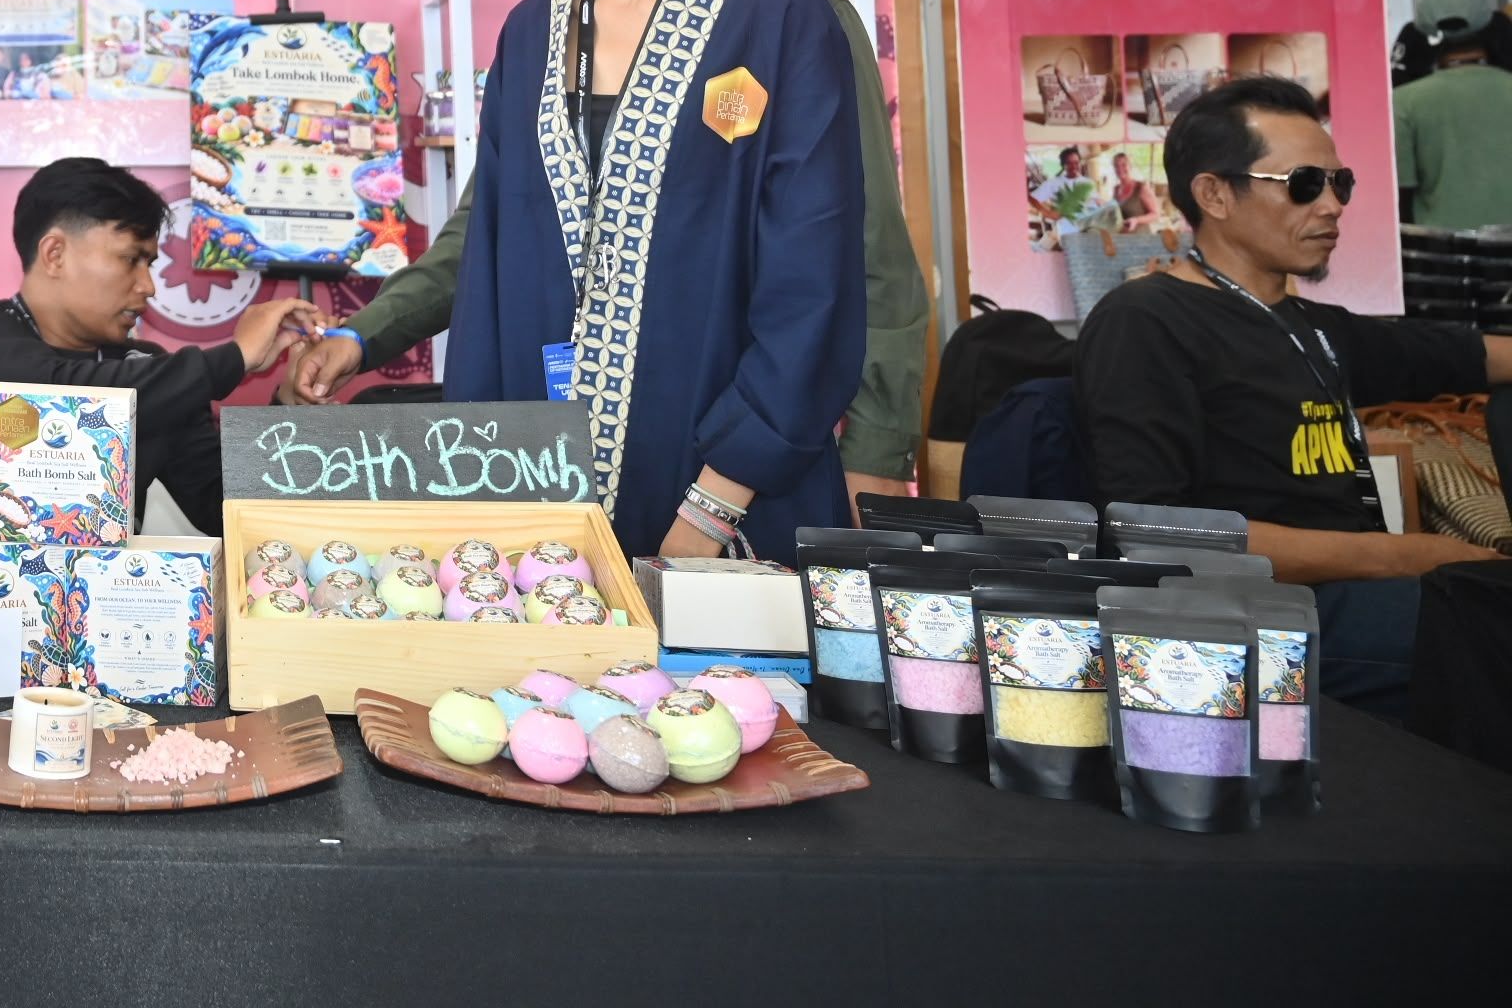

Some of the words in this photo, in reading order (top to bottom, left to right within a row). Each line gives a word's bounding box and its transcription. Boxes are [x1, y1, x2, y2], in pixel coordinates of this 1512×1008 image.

[263, 50, 322, 62] ESTUARIA
[232, 66, 262, 79] Take
[264, 68, 317, 83] Lombok
[1291, 420, 1357, 476] APIK
[29, 449, 85, 461] ESTUARIA
[255, 420, 418, 502] Bath
[18, 467, 41, 478] Bath
[44, 469, 75, 480] Bomb
[77, 471, 96, 481] Salt
[114, 578, 161, 587] ESTUARIA
[22, 617, 37, 628] Salt
[1027, 645, 1069, 653] Aromatherapy
[1160, 668, 1203, 678] Aromatherapy
